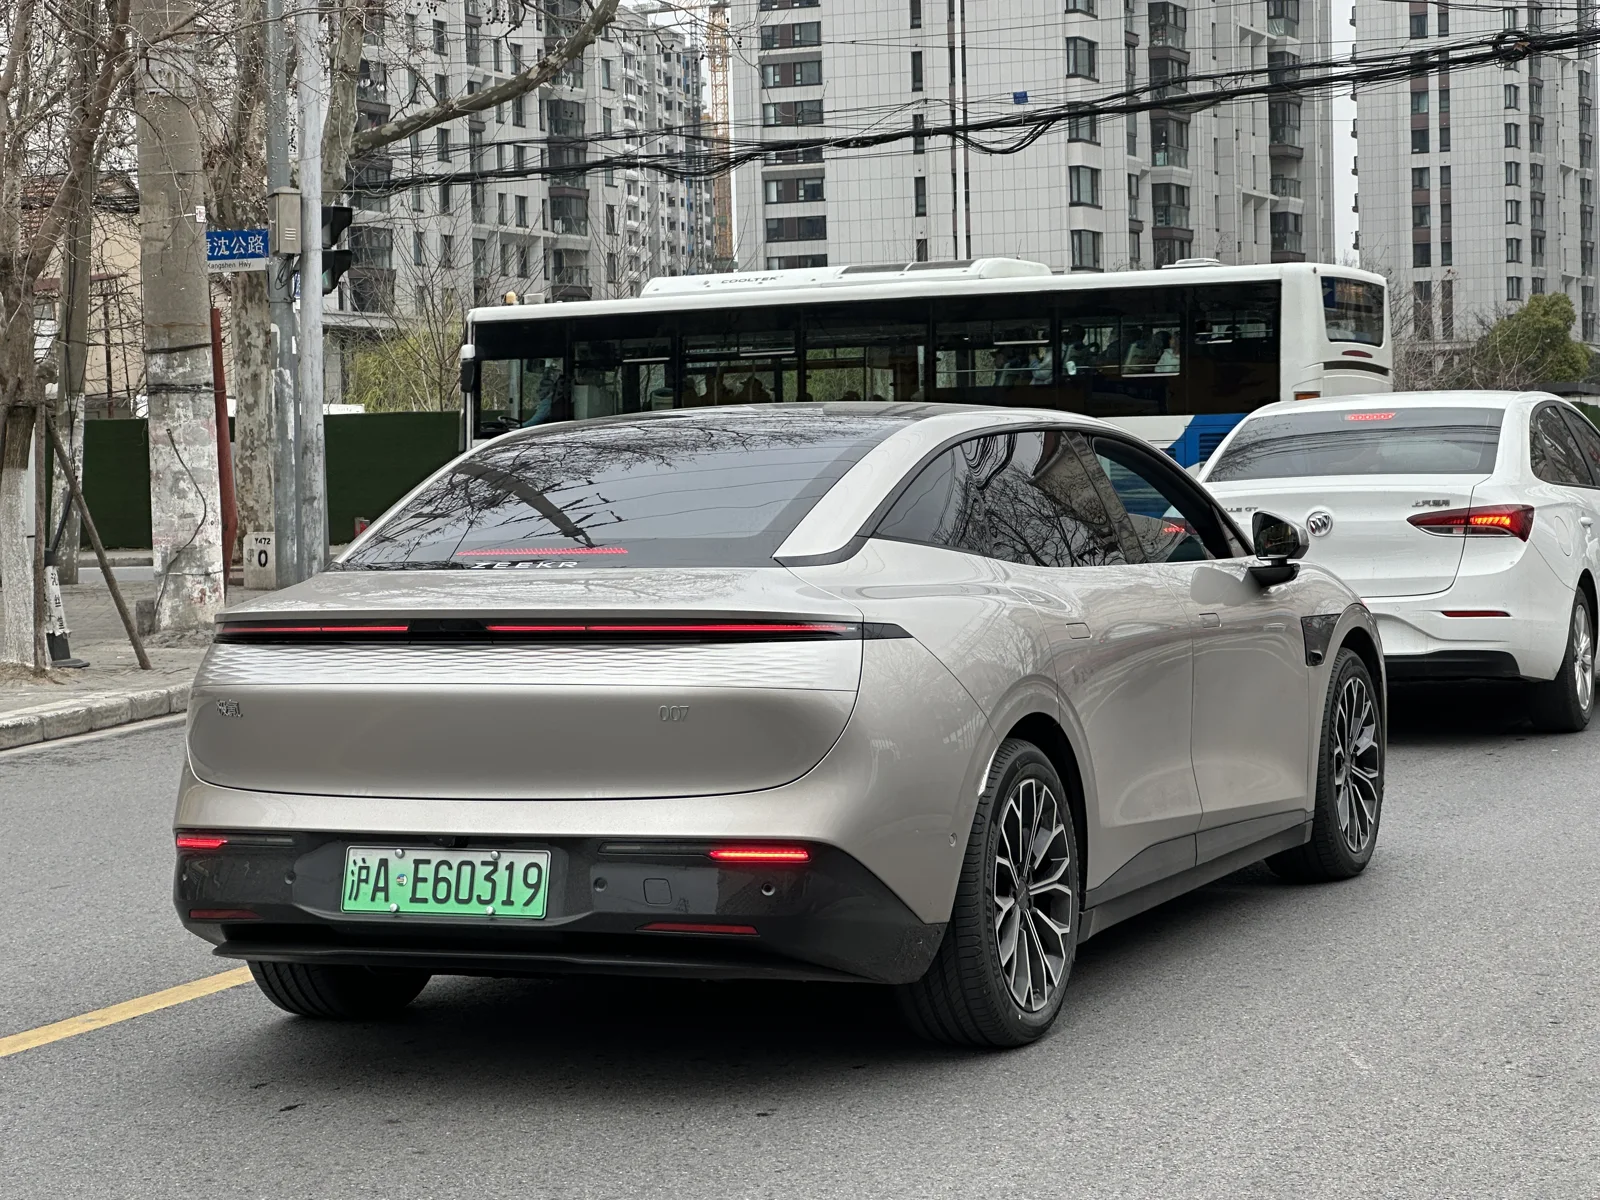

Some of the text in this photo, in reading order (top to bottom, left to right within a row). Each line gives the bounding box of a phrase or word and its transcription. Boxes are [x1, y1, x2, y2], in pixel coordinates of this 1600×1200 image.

[721, 276, 778, 284] COOLTEK
[254, 537, 271, 545] Y472
[471, 561, 578, 569] ZEEKR
[658, 705, 690, 722] 007
